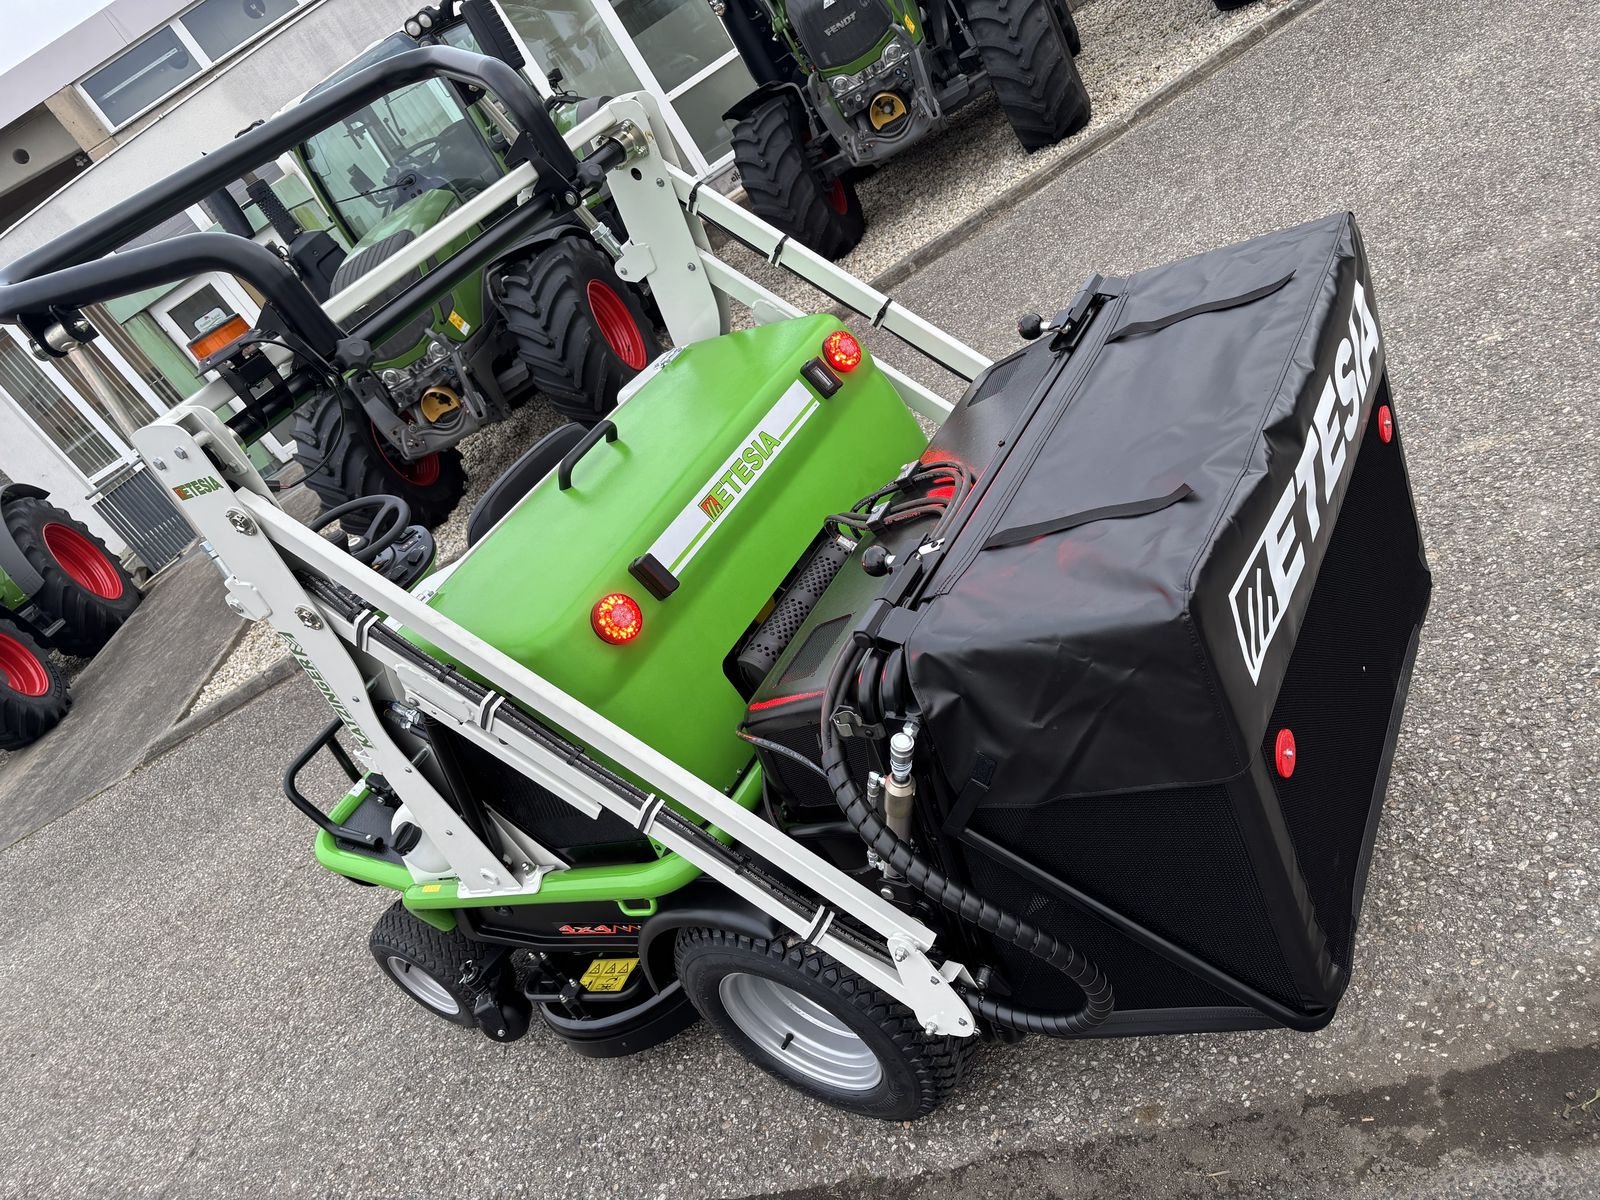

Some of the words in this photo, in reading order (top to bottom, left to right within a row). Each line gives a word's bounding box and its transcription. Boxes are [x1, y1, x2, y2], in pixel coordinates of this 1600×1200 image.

[823, 11, 857, 37] FENDT
[710, 431, 781, 509] ETESIA
[1264, 279, 1380, 615] ETESIA
[178, 476, 224, 500] ETESIA
[298, 658, 374, 749] KATZINGER
